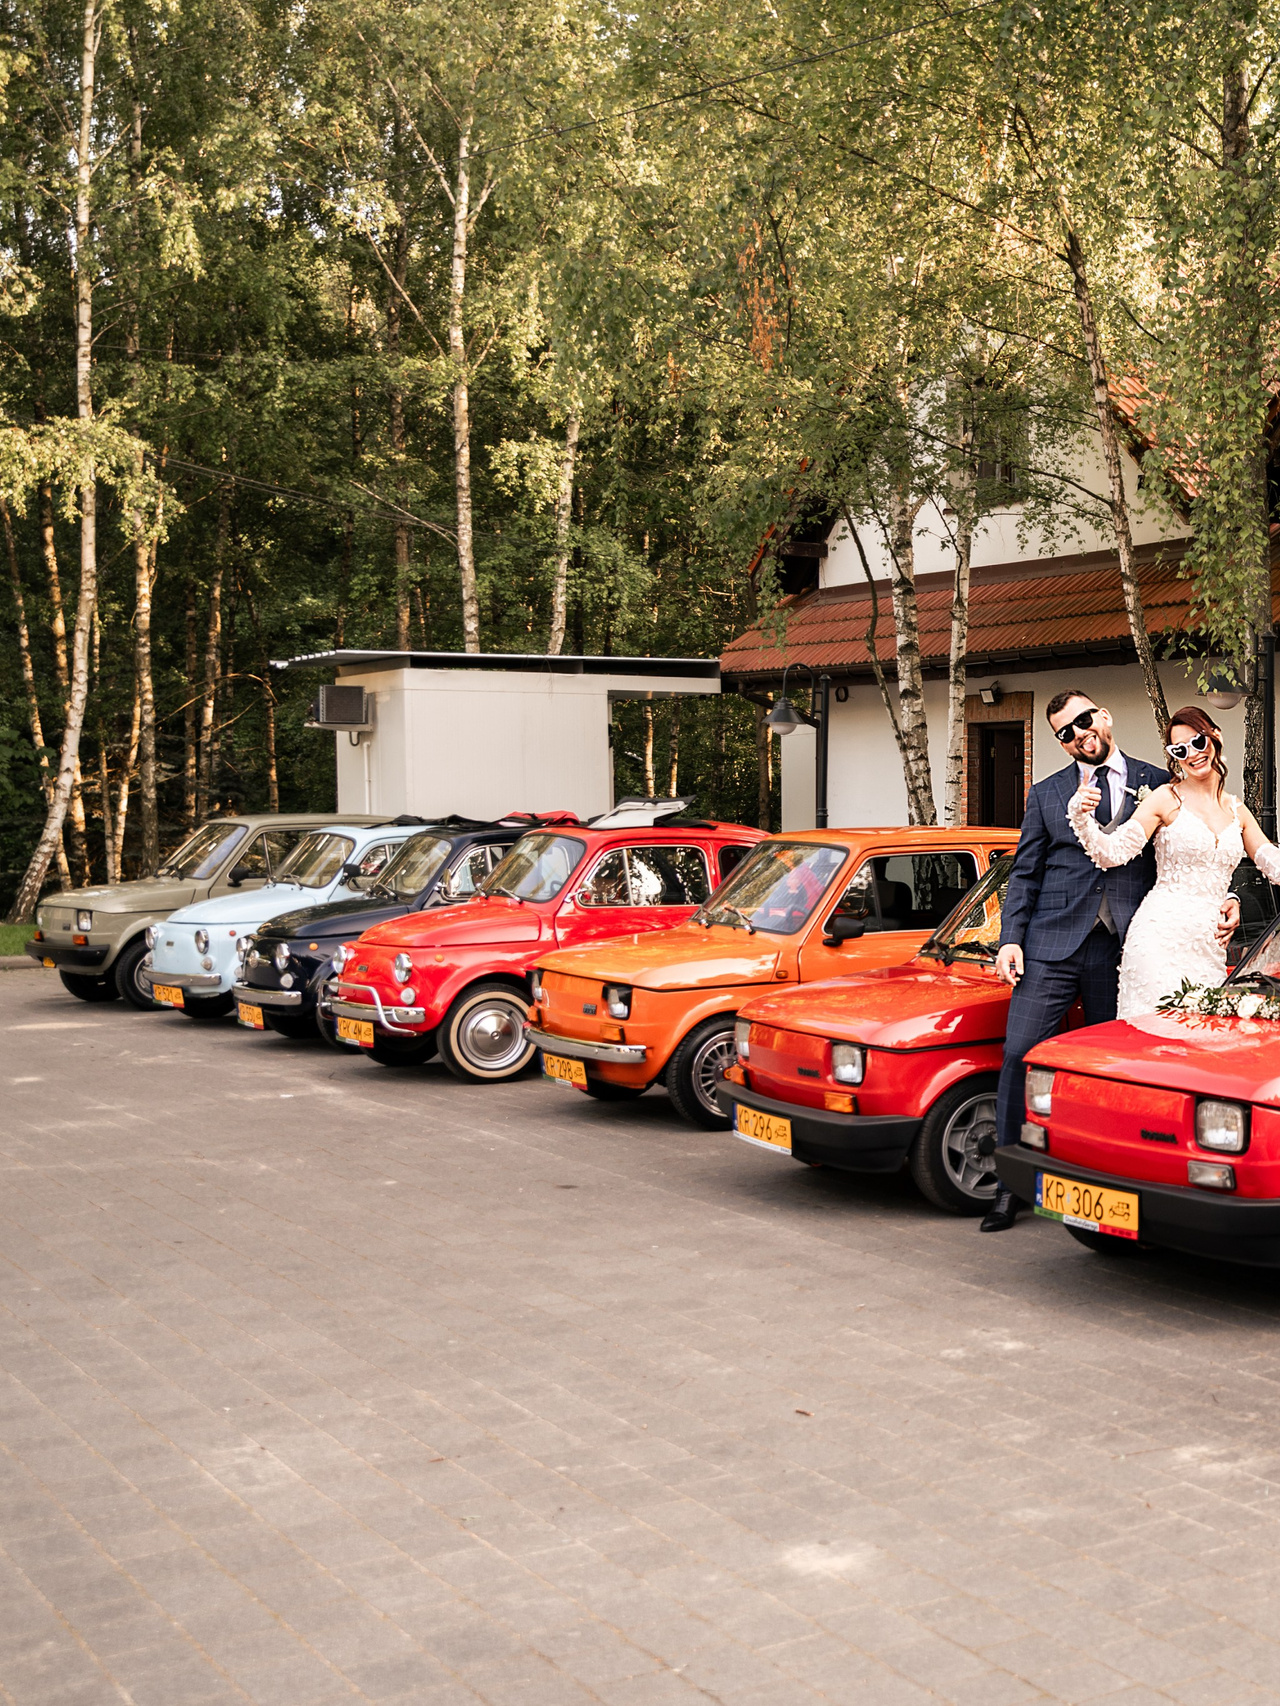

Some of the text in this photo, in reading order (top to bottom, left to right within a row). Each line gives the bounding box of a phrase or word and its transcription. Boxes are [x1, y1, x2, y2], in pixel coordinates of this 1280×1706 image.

[338, 1019, 351, 1037] KRK
[544, 1055, 574, 1080] KR 298
[739, 1107, 751, 1133] KR
[752, 1113, 773, 1140] 296
[1036, 1193, 1043, 1203] PL
[1045, 1178, 1104, 1220] KR 306
